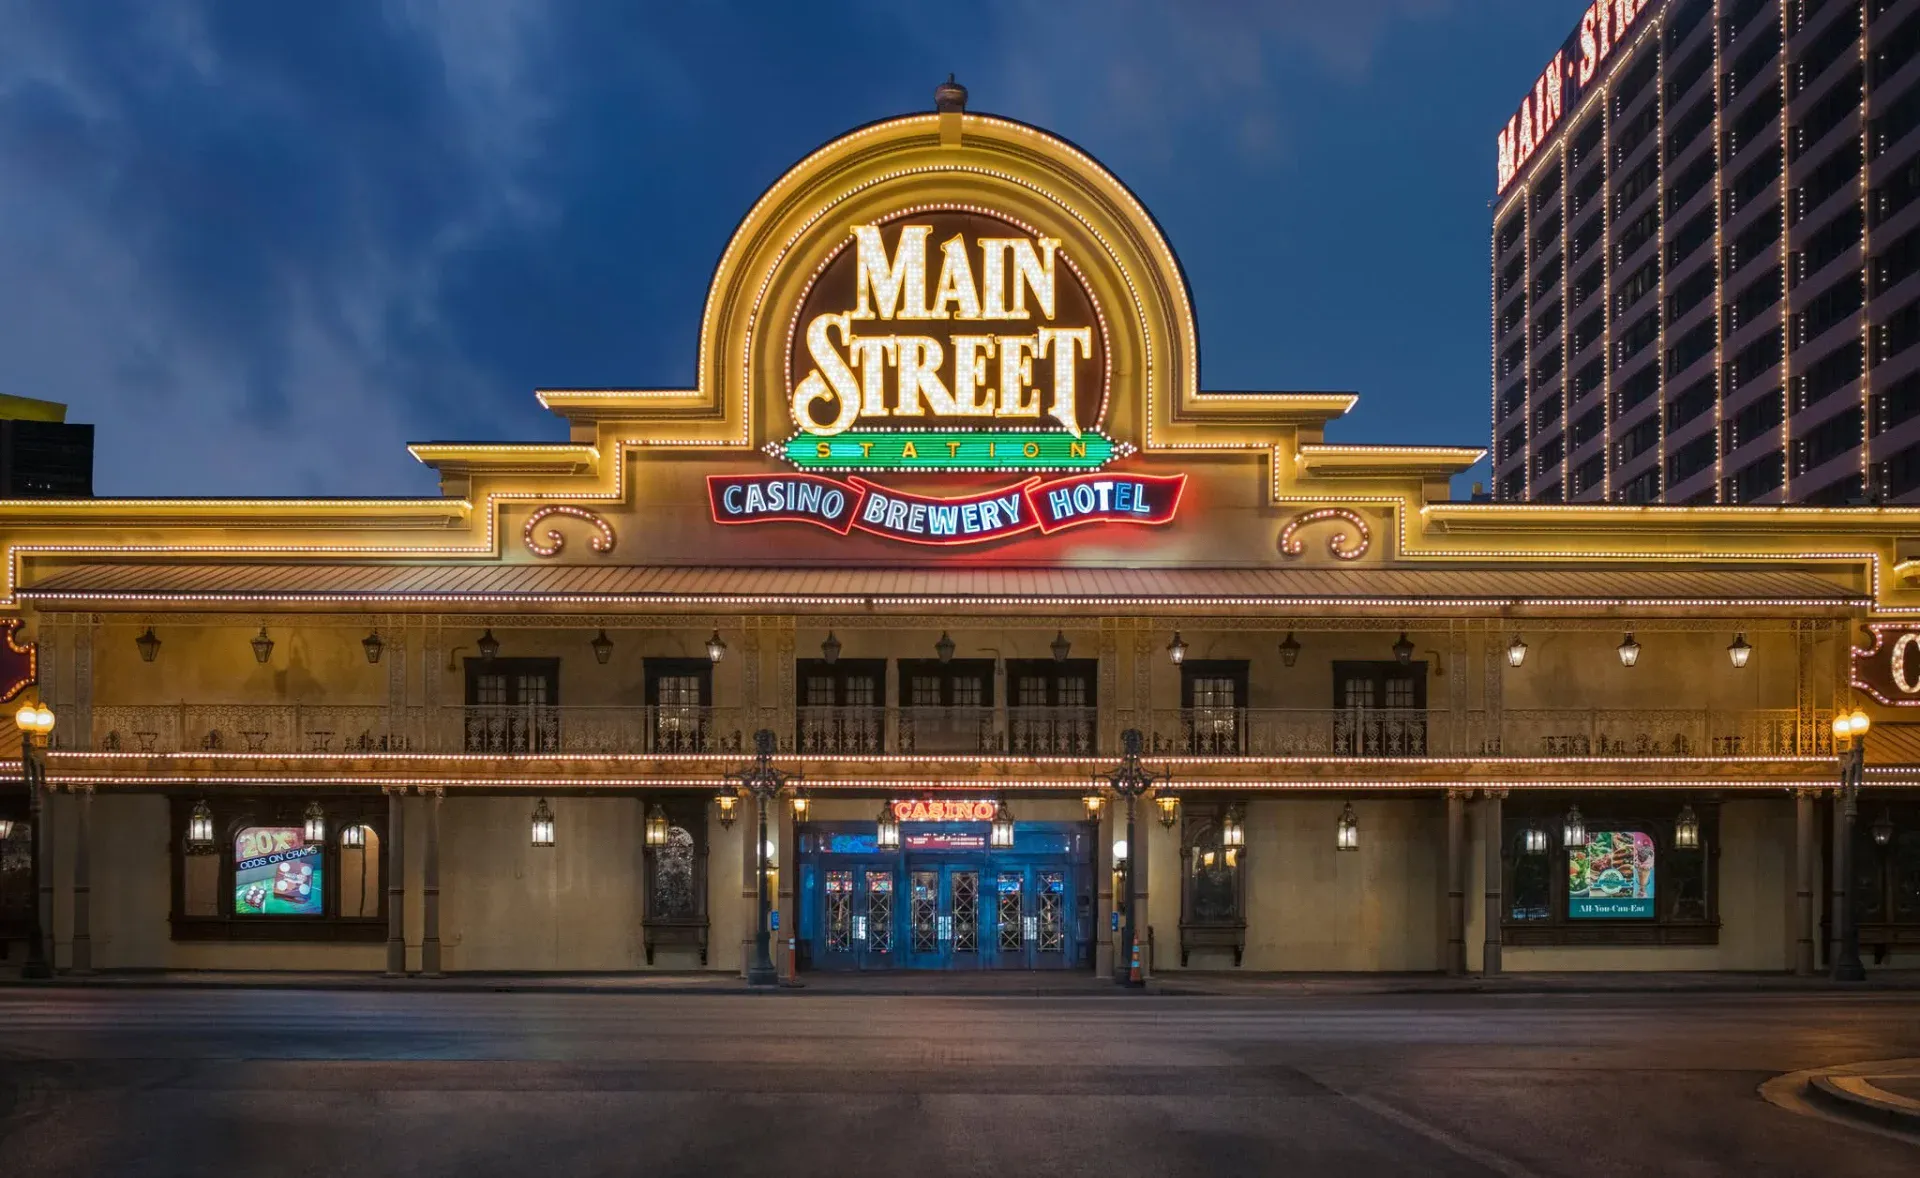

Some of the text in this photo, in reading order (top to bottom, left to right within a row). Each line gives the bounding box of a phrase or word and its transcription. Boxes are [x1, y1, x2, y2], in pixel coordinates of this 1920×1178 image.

[1498, 0, 1648, 195] MAIN ST
[850, 225, 1061, 321] MAIN
[792, 312, 1092, 438] STREET
[817, 441, 1087, 458] STATION
[723, 481, 1150, 535] CASINO BREWERY HOTEL
[894, 802, 994, 819] CASINO
[240, 857, 267, 869] ODDS
[268, 854, 284, 863] ON
